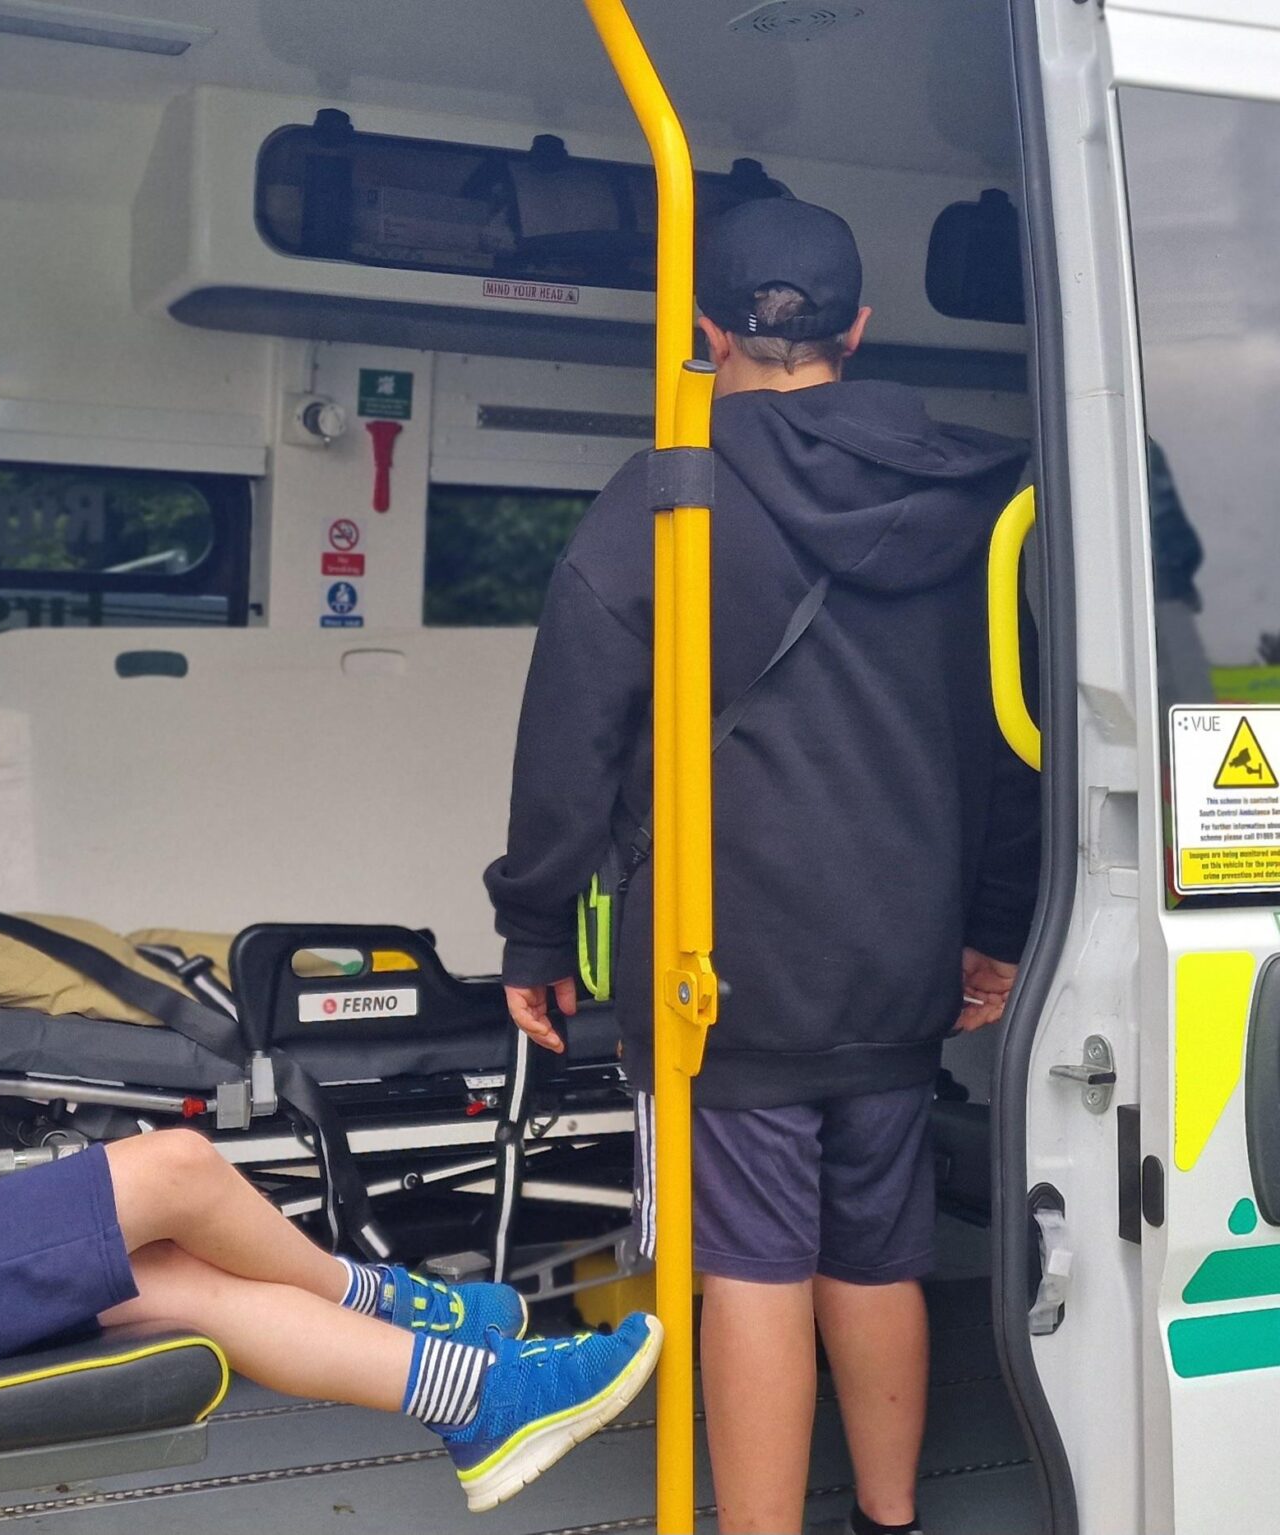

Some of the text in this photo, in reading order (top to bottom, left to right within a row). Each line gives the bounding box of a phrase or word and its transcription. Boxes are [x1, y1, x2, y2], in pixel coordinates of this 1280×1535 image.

[486, 282, 563, 300] MIND YOUR HEAD
[1192, 716, 1221, 732] VUE
[1206, 797, 1219, 805] This
[1220, 797, 1241, 805] scheme
[1250, 796, 1279, 804] controlled
[1199, 809, 1216, 817] South
[1217, 809, 1238, 817] Control
[1239, 808, 1270, 816] Ambulance
[1201, 823, 1210, 831] For
[1233, 822, 1265, 830] information
[1224, 833, 1242, 842] please
[1244, 832, 1255, 840] call
[1189, 851, 1210, 860] Images
[1222, 851, 1238, 860] being
[1239, 849, 1269, 858] monitored
[1223, 861, 1244, 869] vehicle
[1245, 860, 1253, 868] for
[1221, 871, 1252, 880] prevention
[1253, 871, 1264, 879] and
[342, 996, 398, 1013] FERNO
